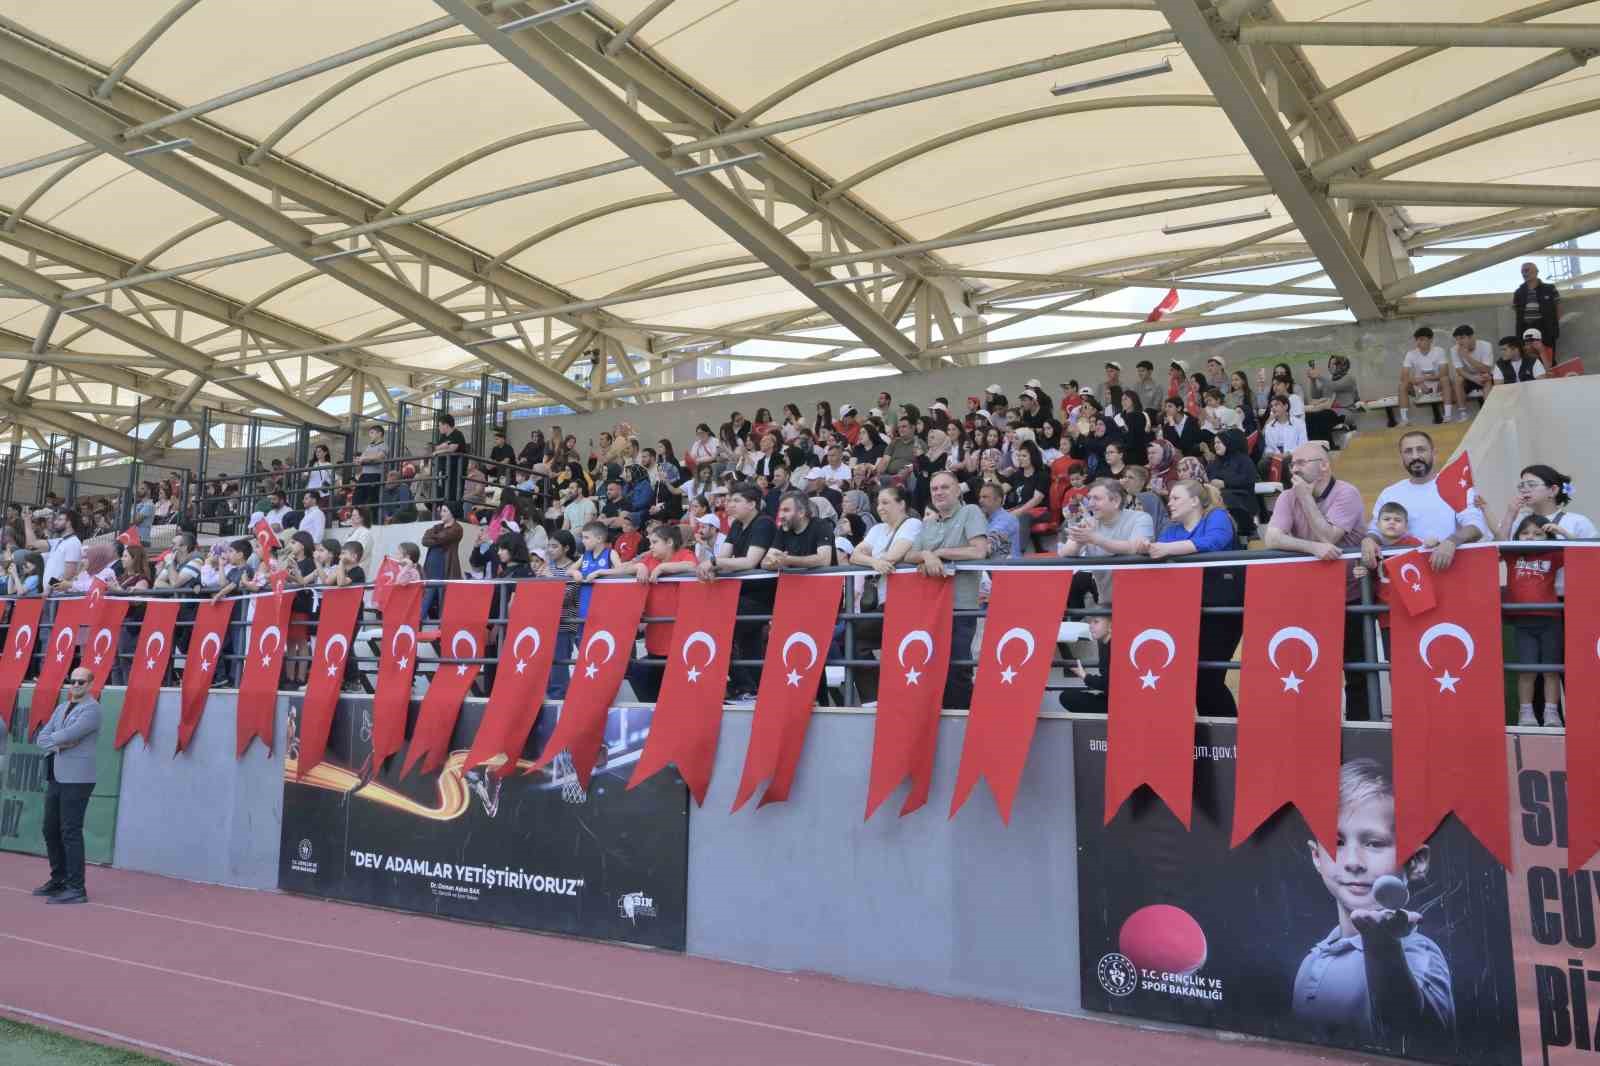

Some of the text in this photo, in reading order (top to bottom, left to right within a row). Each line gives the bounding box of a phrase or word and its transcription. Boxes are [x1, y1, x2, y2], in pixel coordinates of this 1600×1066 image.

[385, 856, 452, 880] ADAMLAR
[1141, 968, 1222, 989] T.C. GENÇLİK VE
[1141, 980, 1223, 1001] SPOR BAKANLIĞI
